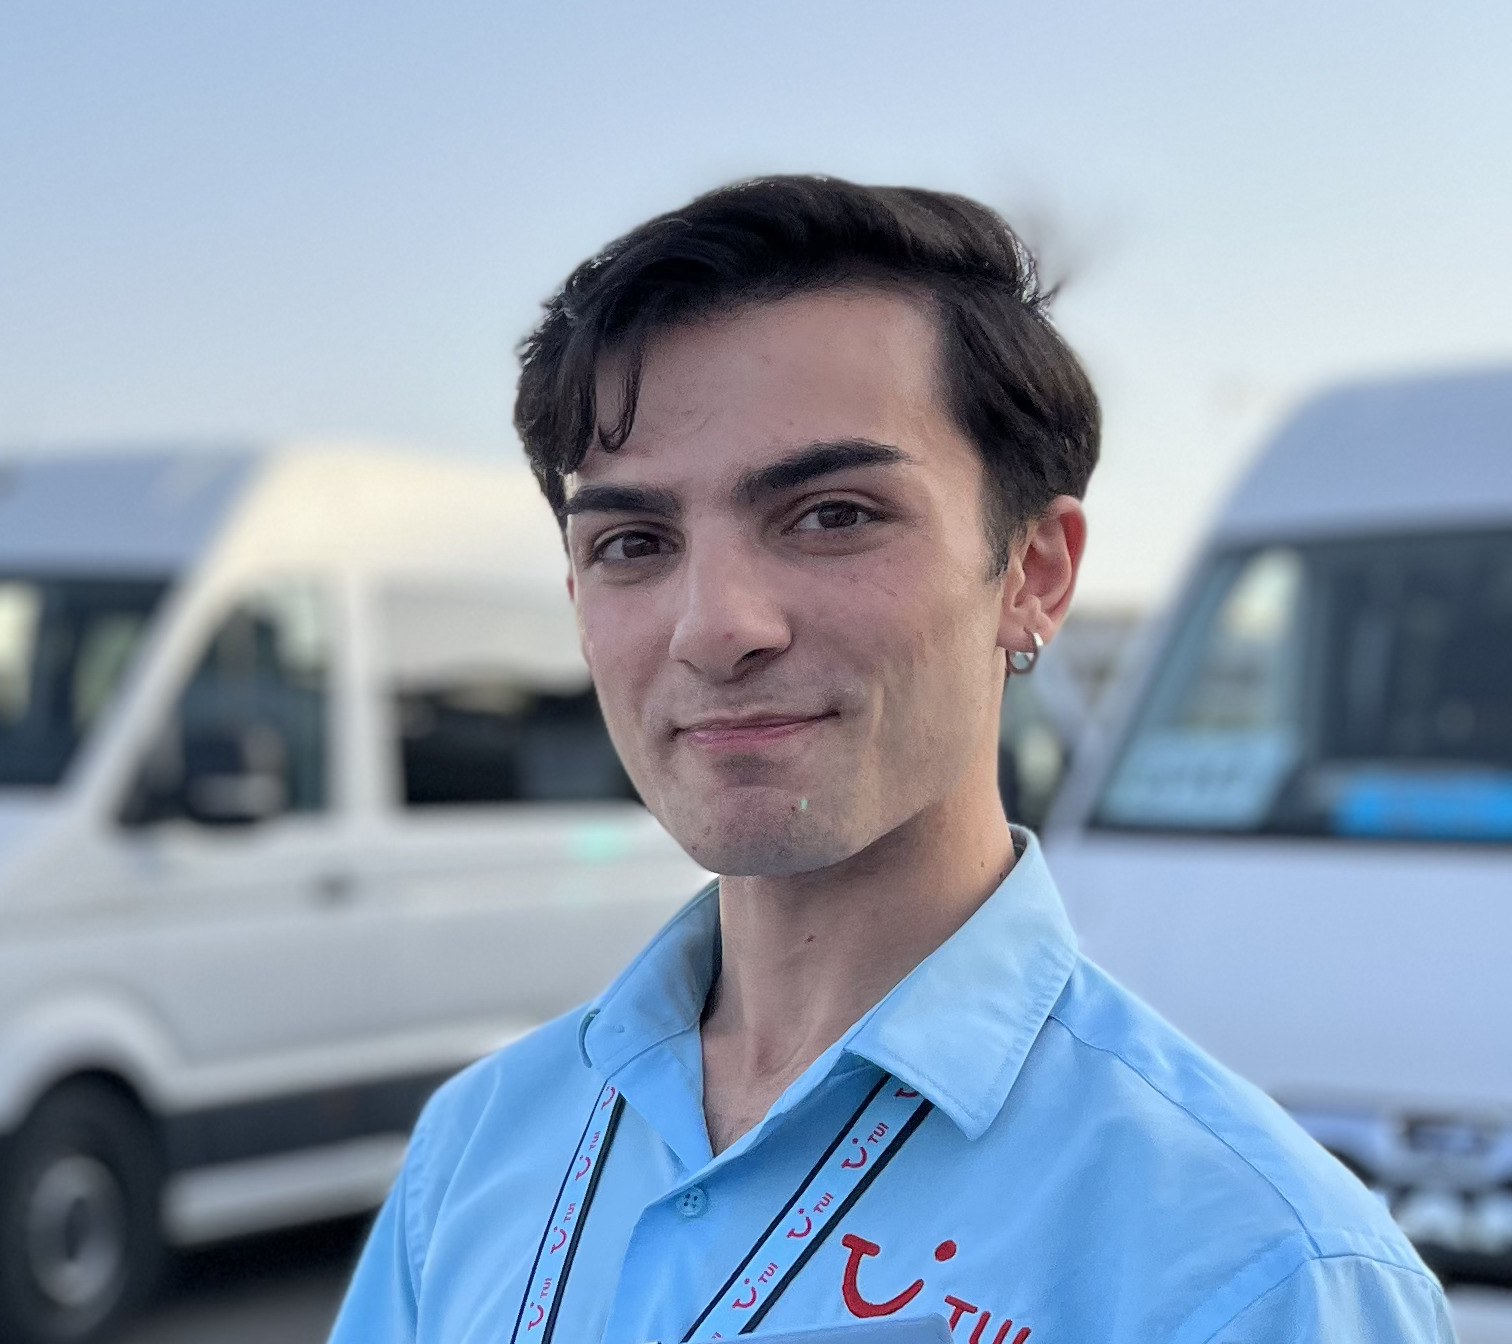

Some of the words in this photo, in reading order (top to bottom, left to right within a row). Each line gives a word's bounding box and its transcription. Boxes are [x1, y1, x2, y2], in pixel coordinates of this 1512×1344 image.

[867, 1122, 889, 1144] TUI
[813, 1192, 834, 1214] TUI
[757, 1262, 778, 1284] TUI
[540, 1277, 552, 1298] TUI
